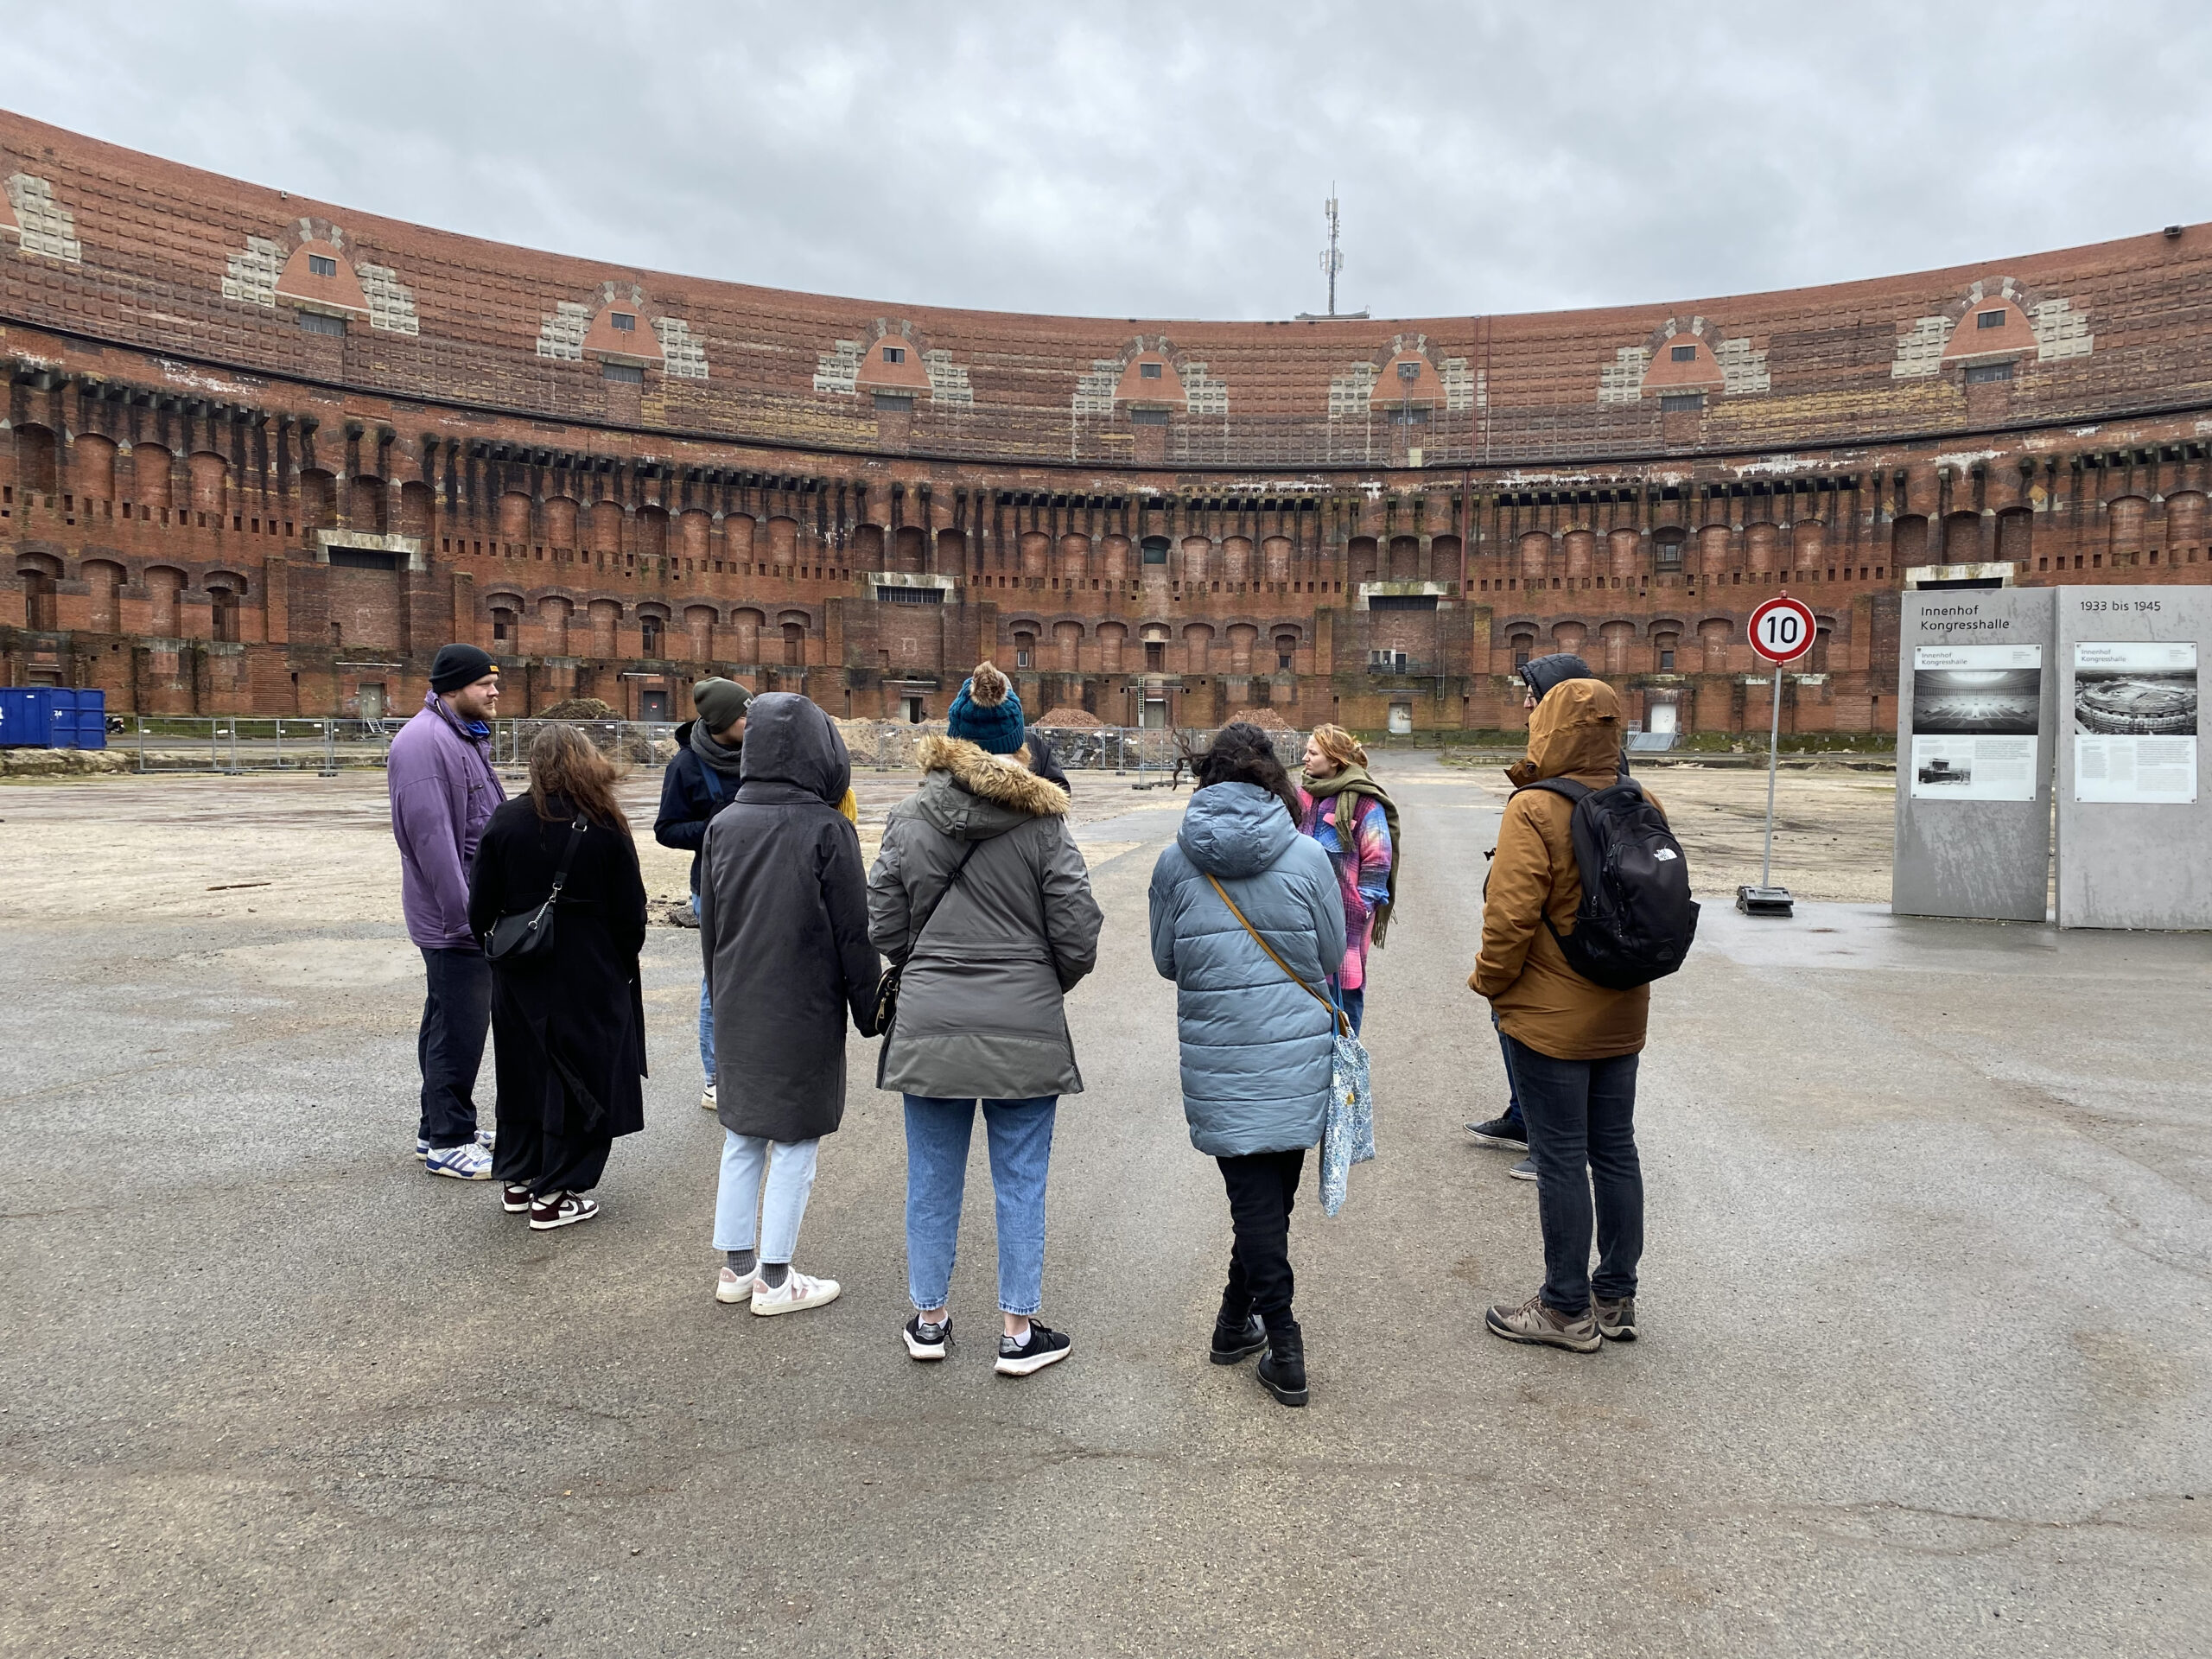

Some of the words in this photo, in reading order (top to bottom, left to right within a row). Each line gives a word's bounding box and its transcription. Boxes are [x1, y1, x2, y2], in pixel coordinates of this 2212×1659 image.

[1921, 605, 1979, 616] Innenhof
[2080, 601, 2107, 612] 1933
[2112, 601, 2130, 612] bis
[2134, 601, 2162, 612] 1945
[1767, 616, 1797, 644] 10
[1921, 619, 2010, 632] Kongresshalle
